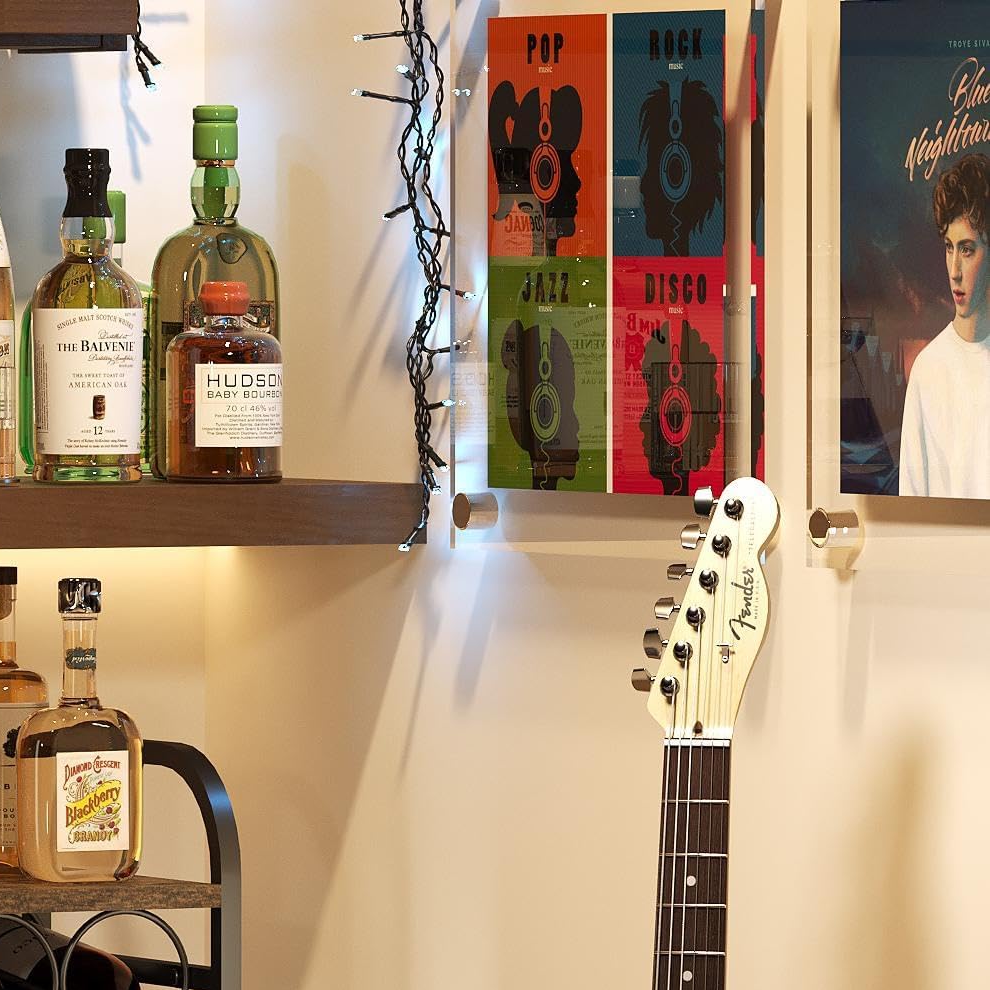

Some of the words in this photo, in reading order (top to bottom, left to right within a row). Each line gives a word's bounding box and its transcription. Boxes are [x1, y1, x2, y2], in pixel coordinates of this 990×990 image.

[527, 32, 564, 64] POP
[649, 28, 703, 60] ROCK
[949, 40, 971, 48] TROYE
[538, 64, 553, 73] music
[668, 61, 683, 70] music
[905, 113, 990, 182] Neighbour
[521, 272, 569, 303] JAZZ
[645, 273, 707, 304] DISCO
[538, 303, 553, 312] music
[668, 305, 683, 314] music
[56, 318, 77, 331] SINGLE
[96, 314, 117, 322] SCOTCH
[57, 343, 78, 352] THE
[81, 339, 133, 352] BALVENIE
[207, 374, 282, 388] HUDSON
[207, 390, 238, 399] BABY
[93, 425, 103, 436] 12
[729, 567, 757, 641] Fender
[63, 761, 92, 791] DIAMOND
[65, 786, 121, 828] Blackberry
[73, 830, 113, 842] BRANDY
